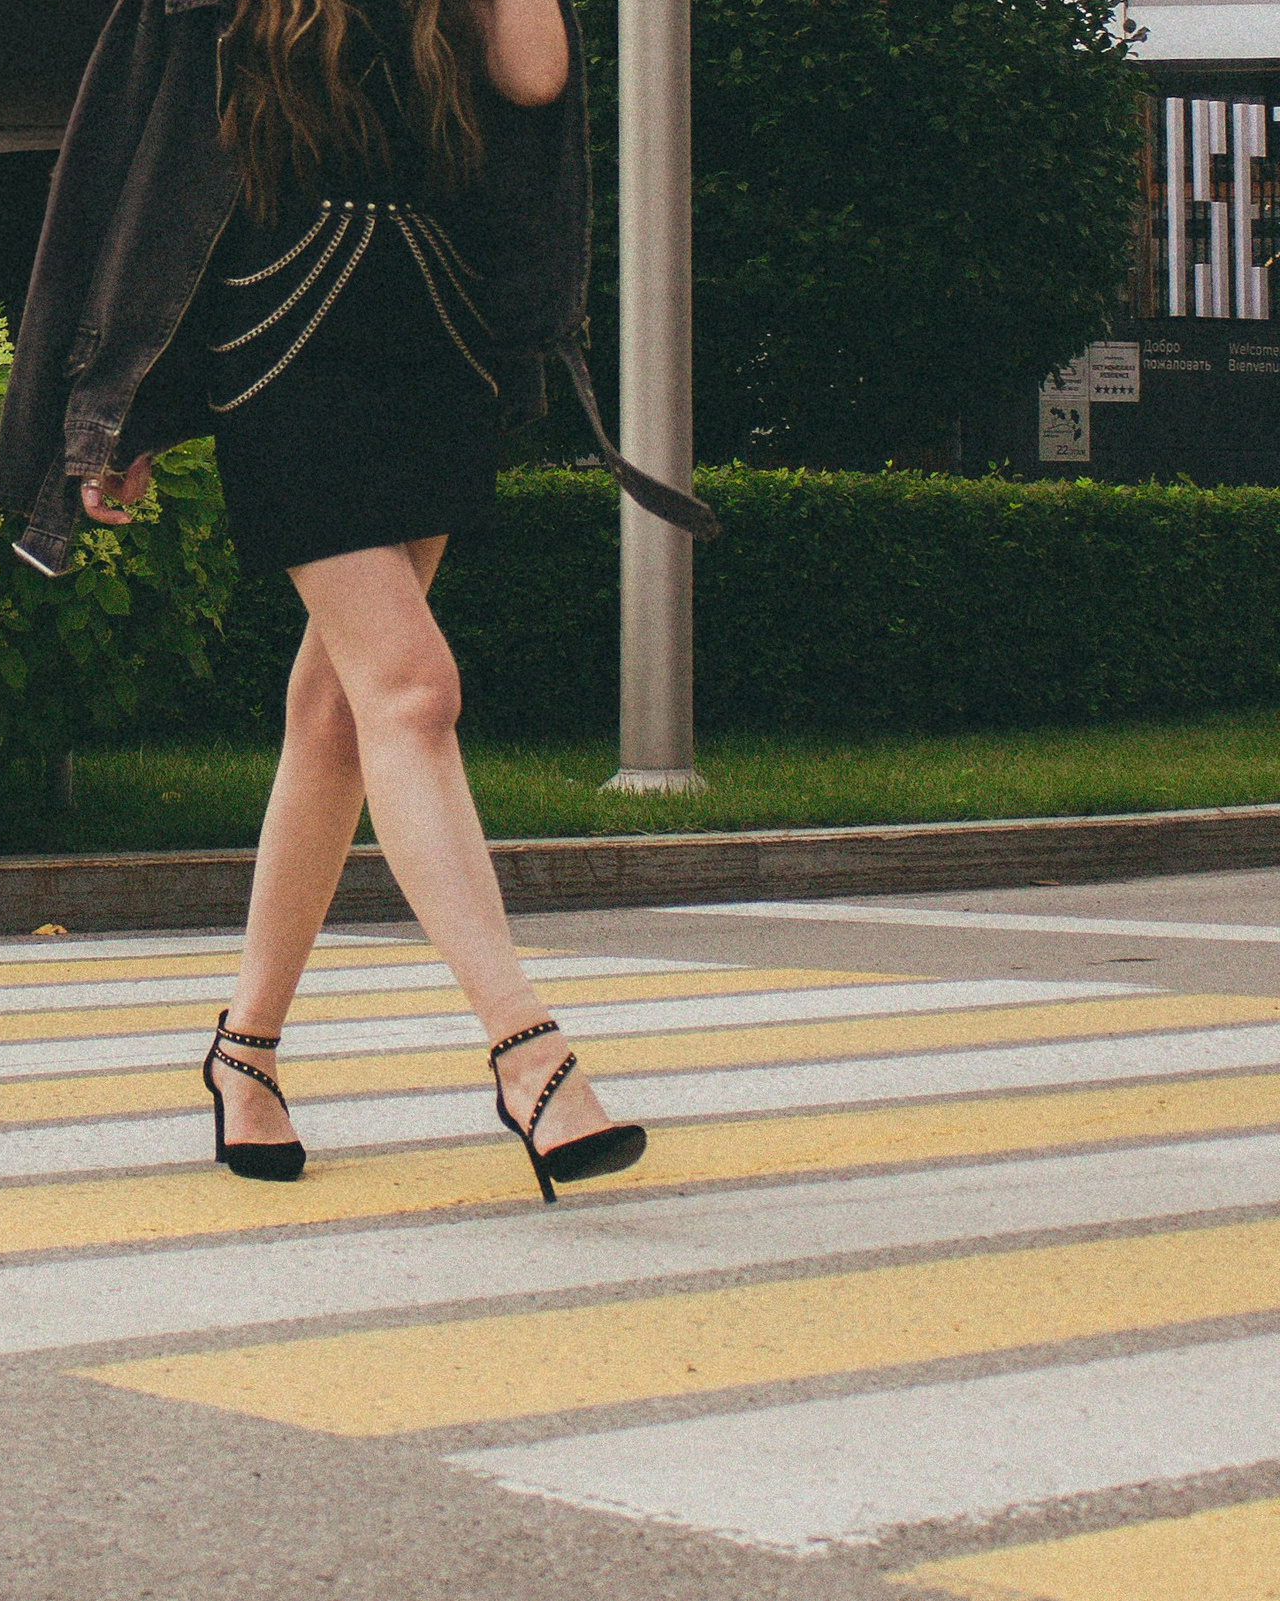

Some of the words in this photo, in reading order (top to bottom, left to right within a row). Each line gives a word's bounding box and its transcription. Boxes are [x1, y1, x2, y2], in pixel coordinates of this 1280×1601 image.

[1166, 97, 1280, 320] ISE
[1143, 338, 1181, 355] Добро
[1229, 342, 1280, 356] Welcome
[1143, 358, 1212, 371] пожаловать
[1056, 445, 1068, 455] 22
